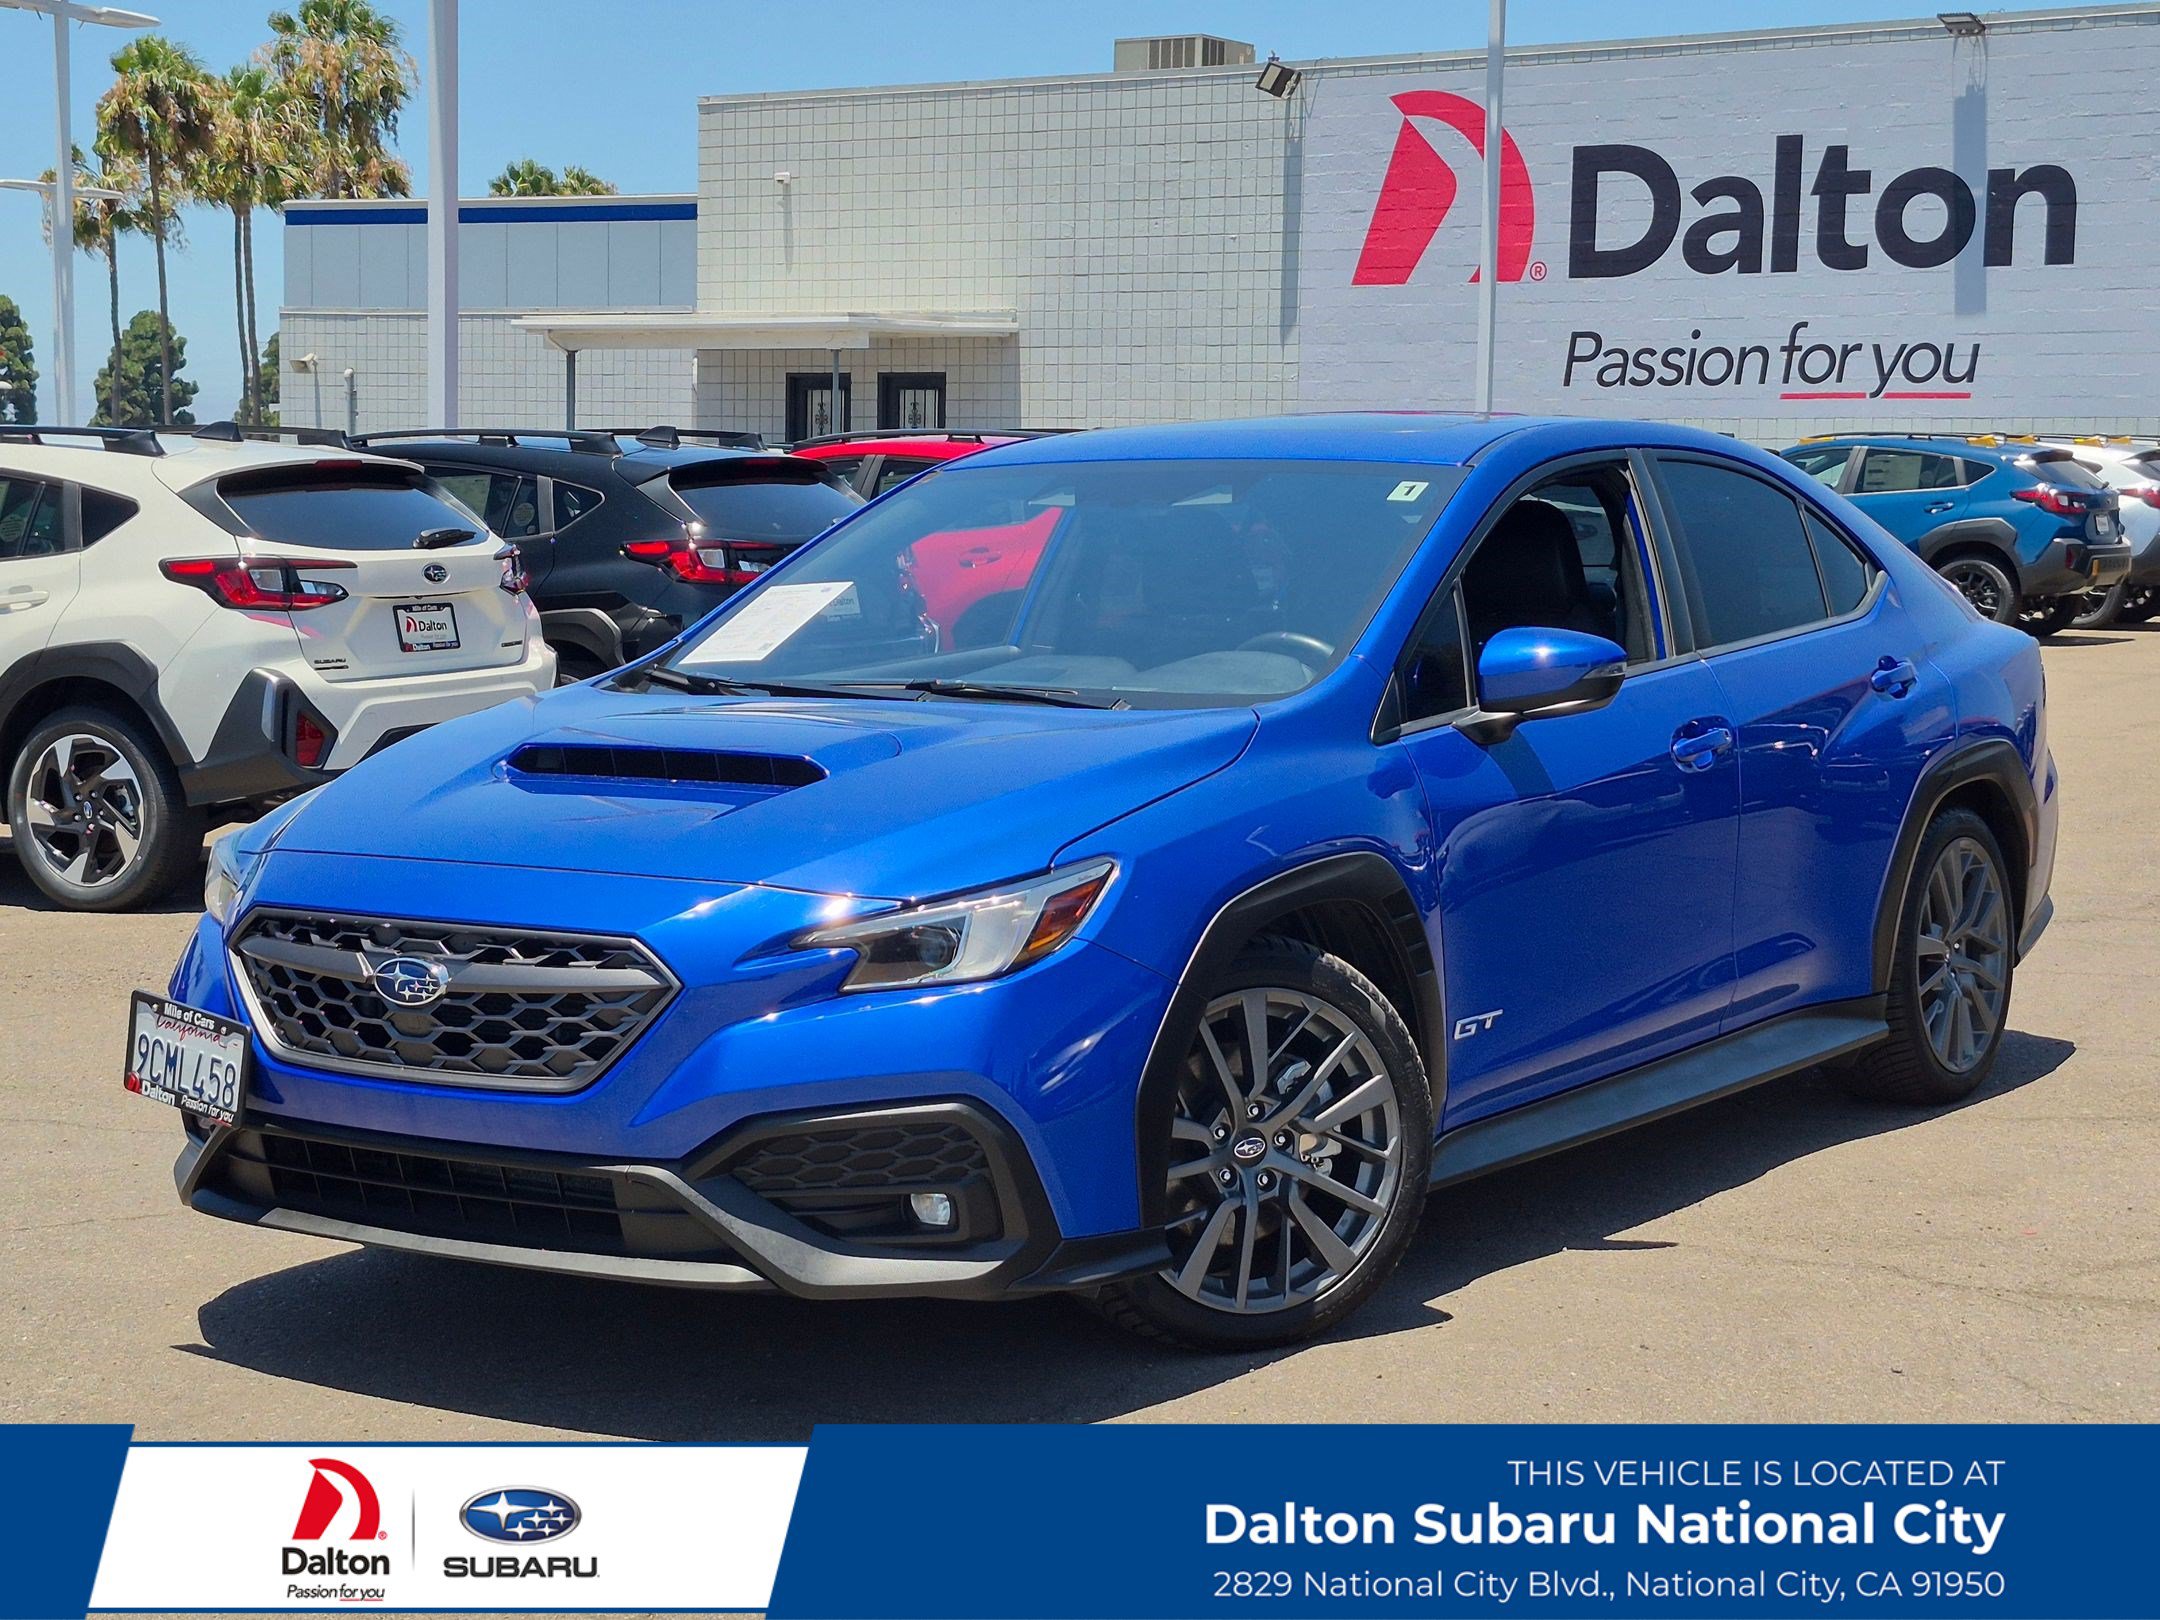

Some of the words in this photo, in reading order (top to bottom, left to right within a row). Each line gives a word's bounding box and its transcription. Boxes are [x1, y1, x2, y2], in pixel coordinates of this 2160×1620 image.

[1568, 134, 2078, 280] Dalton
[1562, 329, 1770, 388] Passion
[1780, 321, 1862, 386] for
[1868, 341, 1981, 399] you
[1403, 484, 1417, 497] 1
[418, 619, 448, 632] Dalton
[164, 1003, 182, 1019] Mile
[183, 1010, 195, 1023] of
[194, 1012, 215, 1030] Cars
[1454, 1008, 1504, 1040] GT
[136, 1031, 237, 1108] 9CML458
[141, 1080, 176, 1106] Dalton
[181, 1094, 208, 1113] Passion
[208, 1104, 220, 1117] for
[219, 1109, 234, 1123] you
